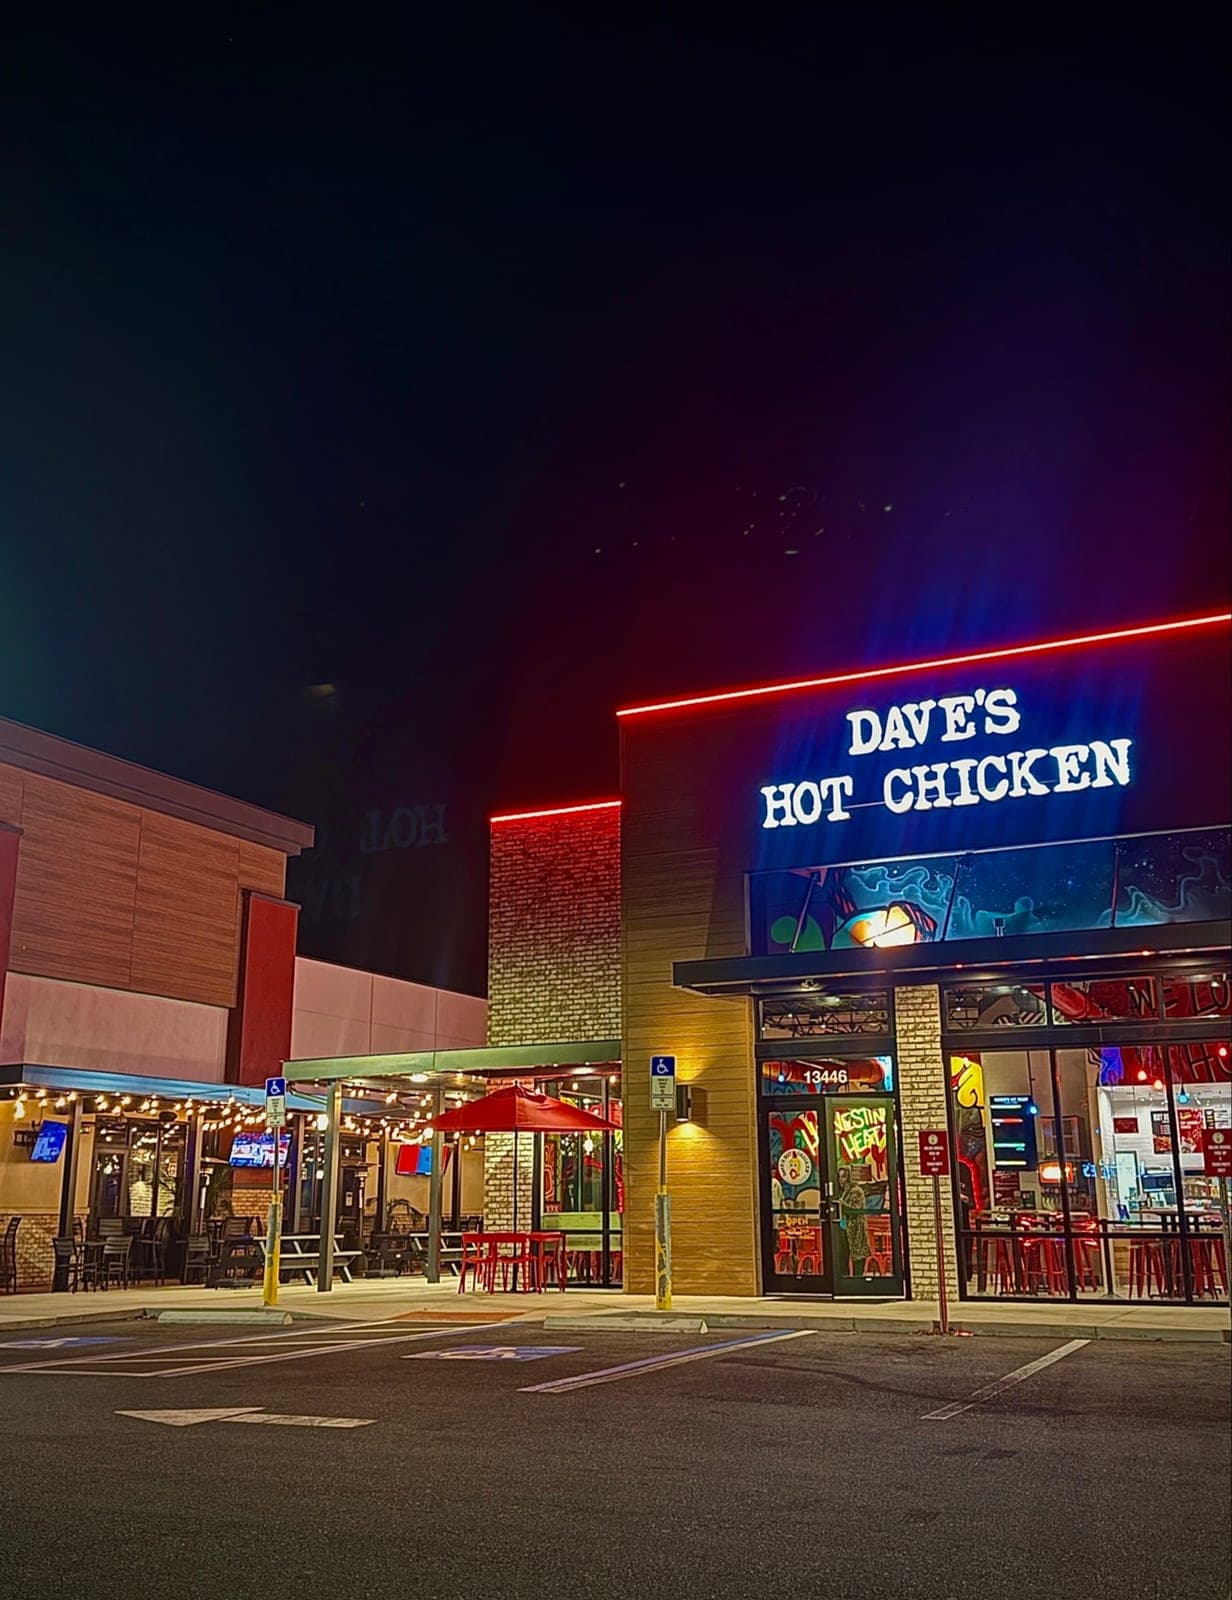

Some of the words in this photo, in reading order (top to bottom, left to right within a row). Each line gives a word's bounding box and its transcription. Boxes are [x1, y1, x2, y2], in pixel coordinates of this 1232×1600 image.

[846, 689, 1021, 755] DAVE'S
[760, 776, 853, 828] HOT
[883, 738, 1133, 814] CHICKEN
[803, 1070, 848, 1084] 13446
